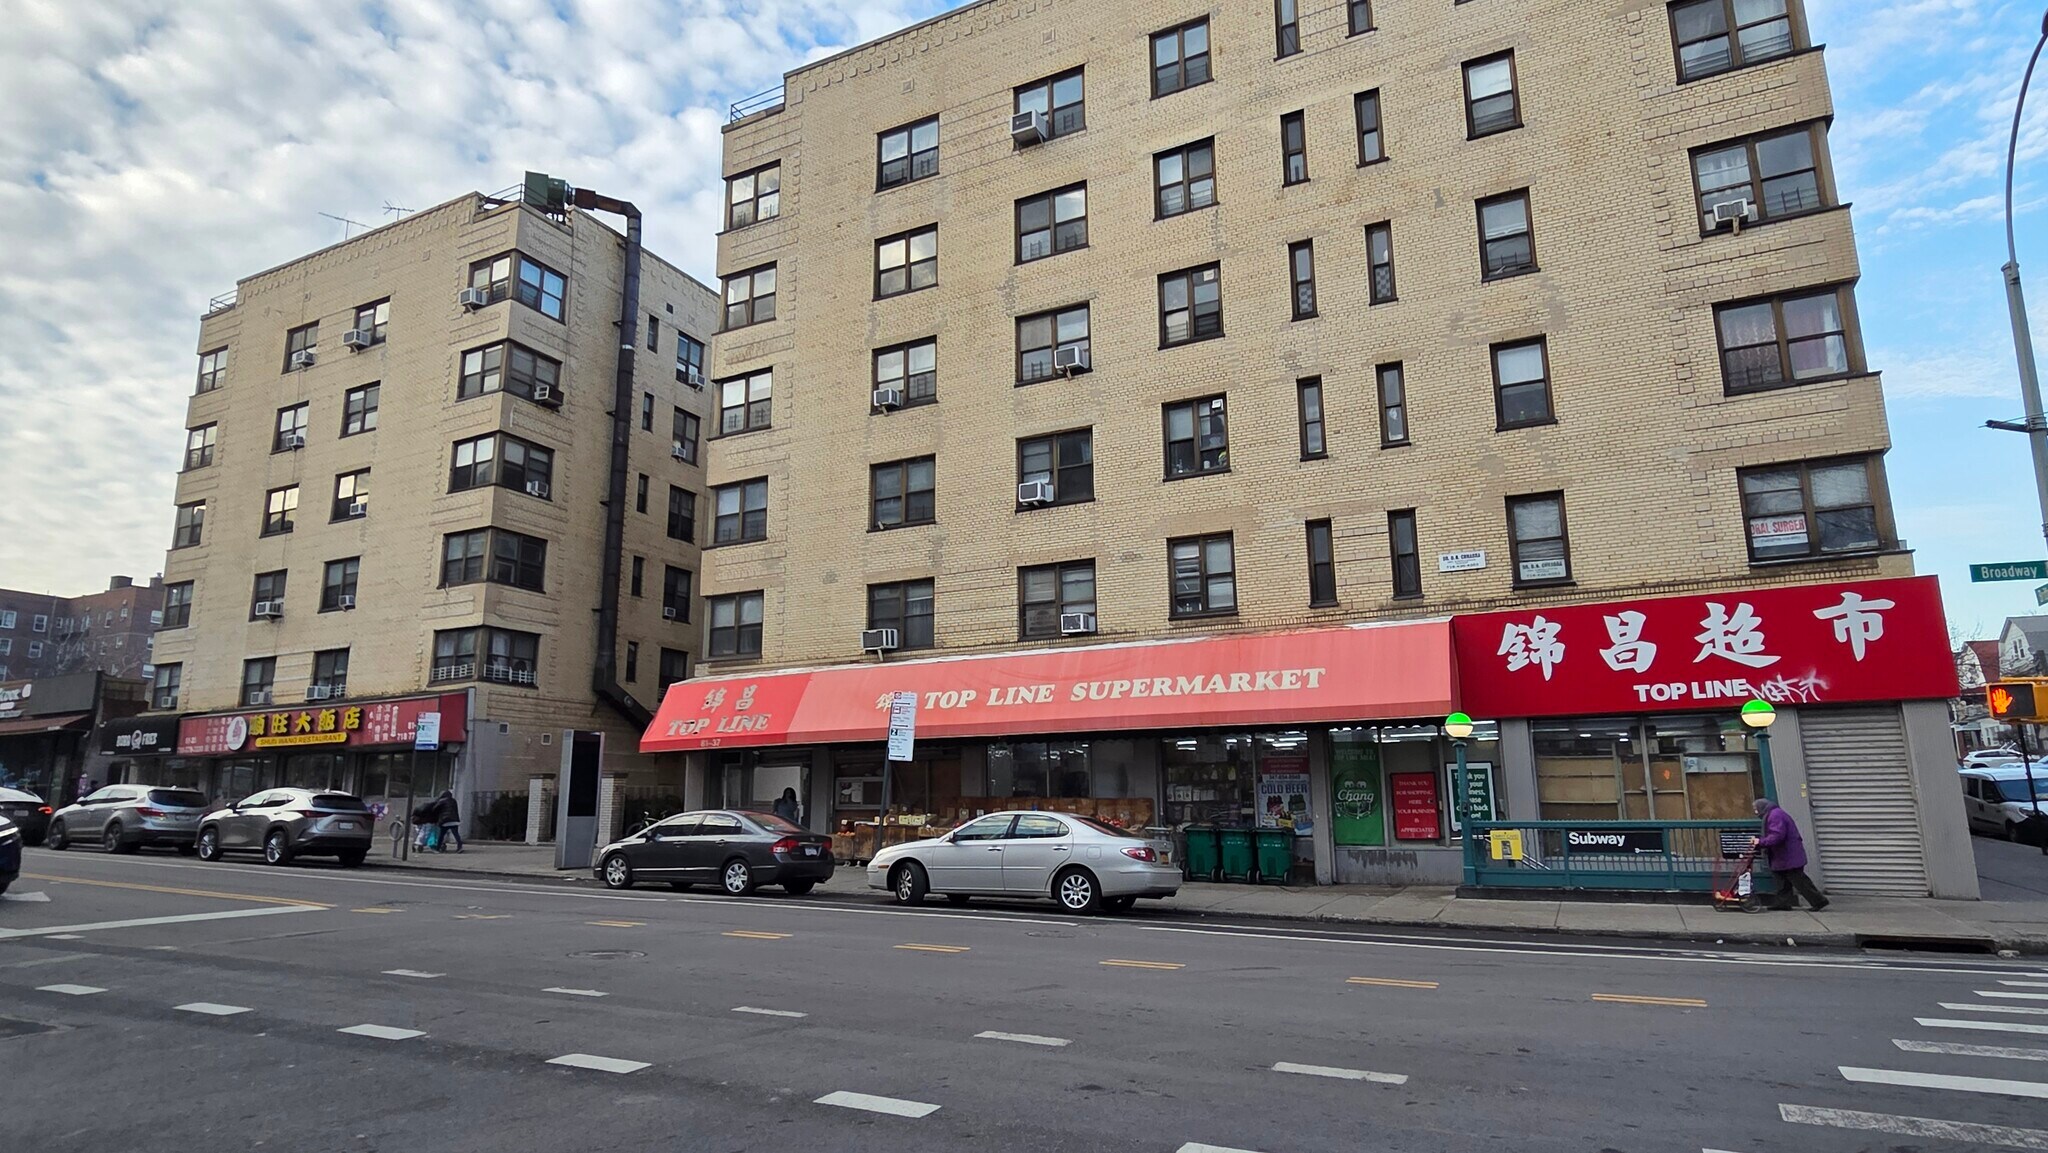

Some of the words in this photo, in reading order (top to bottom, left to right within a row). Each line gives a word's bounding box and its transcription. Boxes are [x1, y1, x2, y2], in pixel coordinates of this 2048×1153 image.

[1981, 565, 2037, 579] Broadway
[1497, 592, 1896, 682] 錦昌超市
[925, 690, 977, 709] TOP
[987, 684, 1056, 707] LINE
[1070, 667, 1327, 702] SUPERMARKET
[1633, 682, 1687, 702] TOP
[1691, 678, 1749, 699] LINE
[666, 718, 710, 737] TOP
[715, 714, 772, 734] LINE
[298, 734, 341, 743] RESTAURANT
[1473, 773, 1485, 781] you
[1261, 784, 1283, 794] COLD
[1285, 783, 1308, 793] BEER
[1337, 789, 1374, 803] Chang
[1568, 832, 1625, 847] Subway
